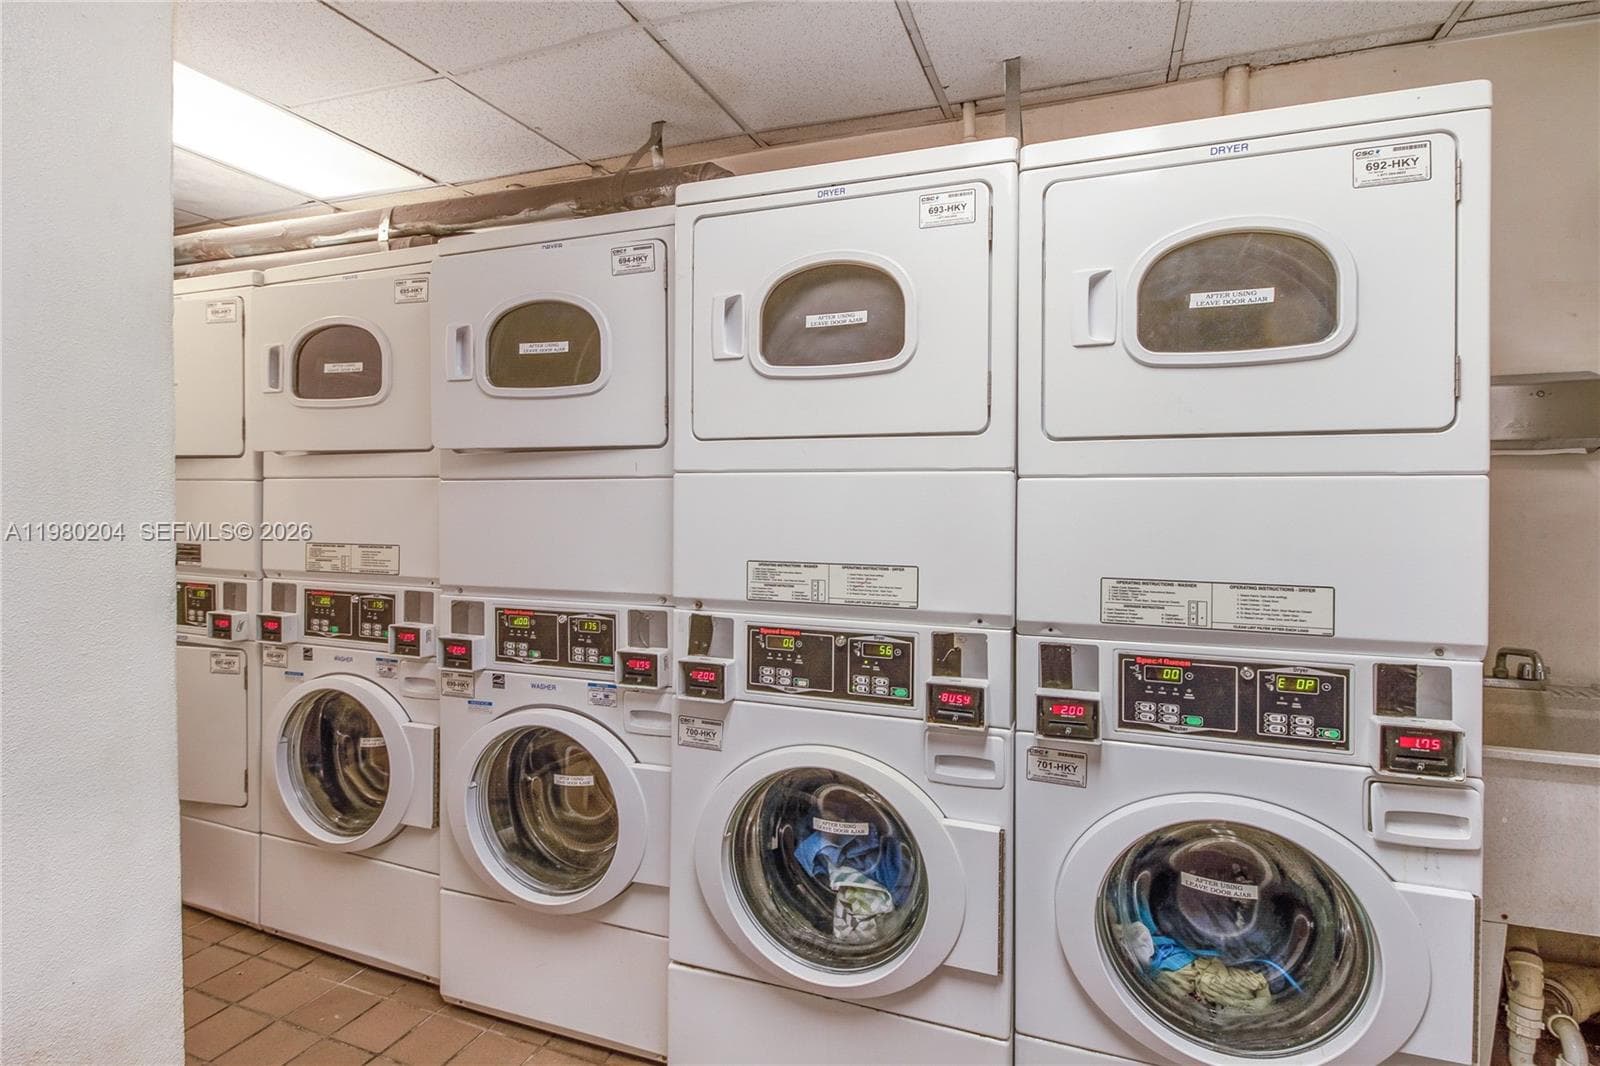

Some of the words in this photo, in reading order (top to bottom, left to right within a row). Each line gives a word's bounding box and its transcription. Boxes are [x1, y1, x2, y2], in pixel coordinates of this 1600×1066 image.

[1210, 143, 1249, 156] DRYER
[1355, 149, 1375, 157] CSC
[1365, 157, 1420, 172] 692-HKY
[817, 187, 846, 199] DRYER
[928, 203, 967, 215] 693-HKY
[1232, 289, 1257, 298] USING
[879, 645, 892, 656] 56
[1163, 669, 1180, 680] 00
[530, 682, 557, 691] WASHER
[685, 727, 718, 739] 700-HKY
[1036, 760, 1079, 774] 701-HKY
[1185, 880, 1209, 891] LEAVE
[1210, 887, 1232, 896] DOOR
[1195, 877, 1218, 887] AFTER
[1220, 882, 1243, 891] USING
